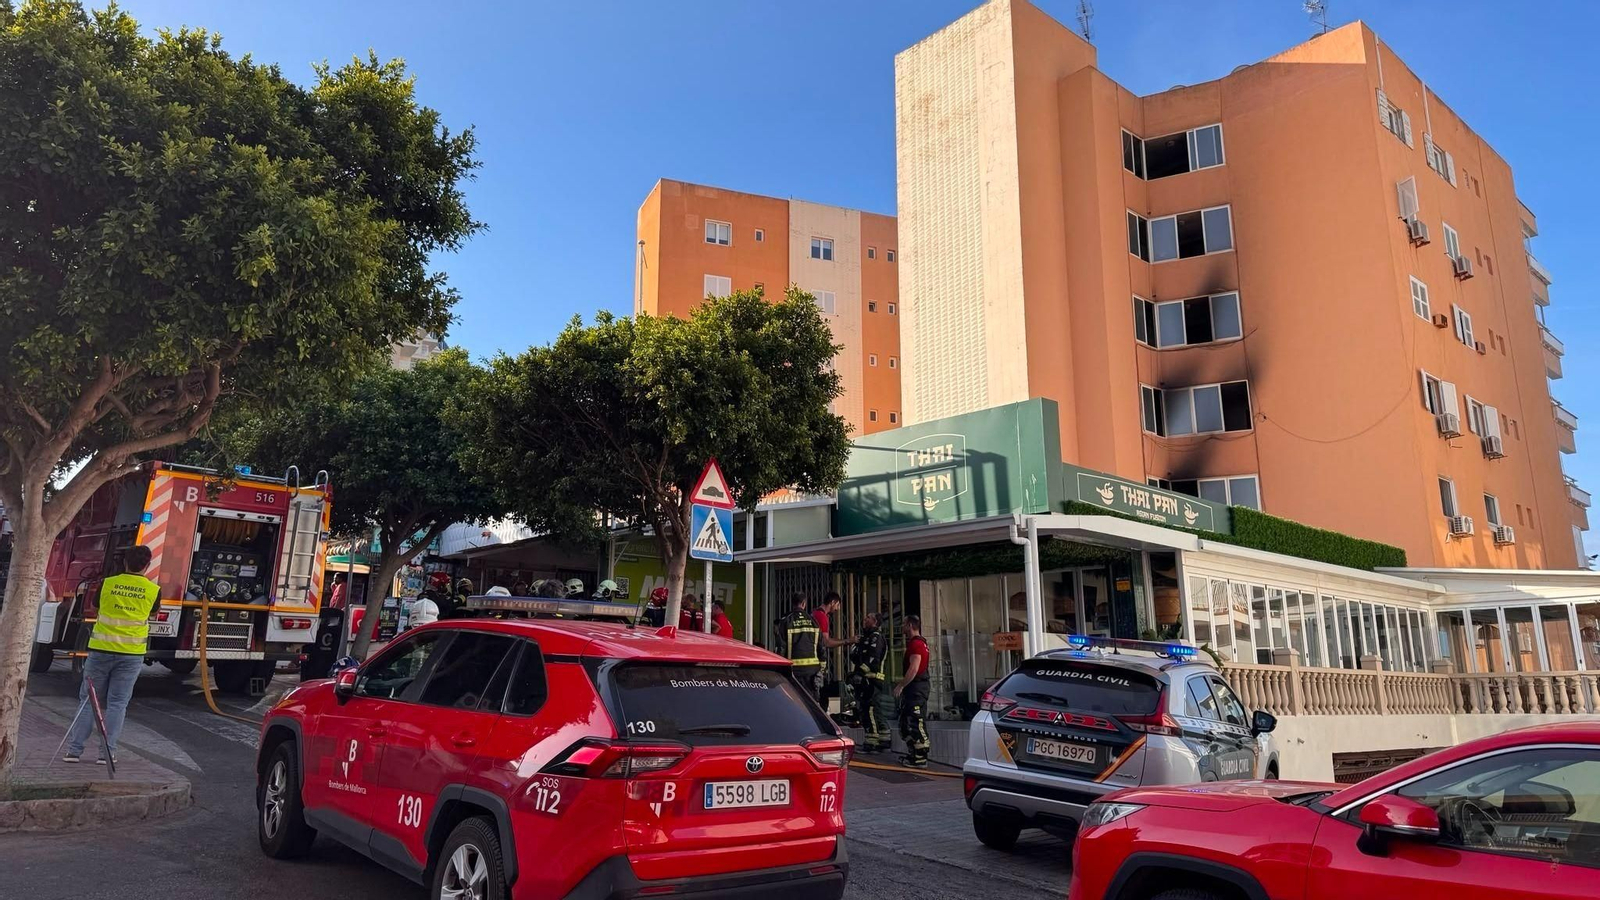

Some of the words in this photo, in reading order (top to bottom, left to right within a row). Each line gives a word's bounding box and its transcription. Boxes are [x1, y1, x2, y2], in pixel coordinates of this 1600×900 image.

[907, 444, 953, 467] THAI
[911, 473, 951, 495] PAN
[186, 486, 198, 502] B
[255, 492, 275, 503] 516
[1120, 485, 1150, 509] THAI
[1152, 493, 1178, 516] PAN
[110, 590, 146, 600] MALLORCA
[114, 584, 146, 593] BOMBERS
[639, 574, 738, 605] MGNET
[670, 679, 715, 688] Bombers
[716, 679, 729, 688] de
[729, 679, 769, 690] Mallorca
[1036, 669, 1093, 680] GUARDIA
[1097, 675, 1130, 687] CIVIL
[627, 720, 656, 734] 130
[1034, 740, 1054, 755] PGC
[1067, 735, 1097, 743] CROSS
[349, 739, 358, 762] B
[1221, 759, 1238, 776] GUARDIA
[1238, 757, 1249, 773] CIVIL
[328, 780, 344, 791] Bombers
[350, 783, 367, 795] Mallorca
[541, 777, 560, 788] SOS
[662, 781, 677, 802] B
[535, 787, 561, 814] 112
[716, 784, 755, 805] 5598
[761, 783, 787, 803] LGB
[820, 794, 835, 812] 112
[398, 794, 422, 828] 130
